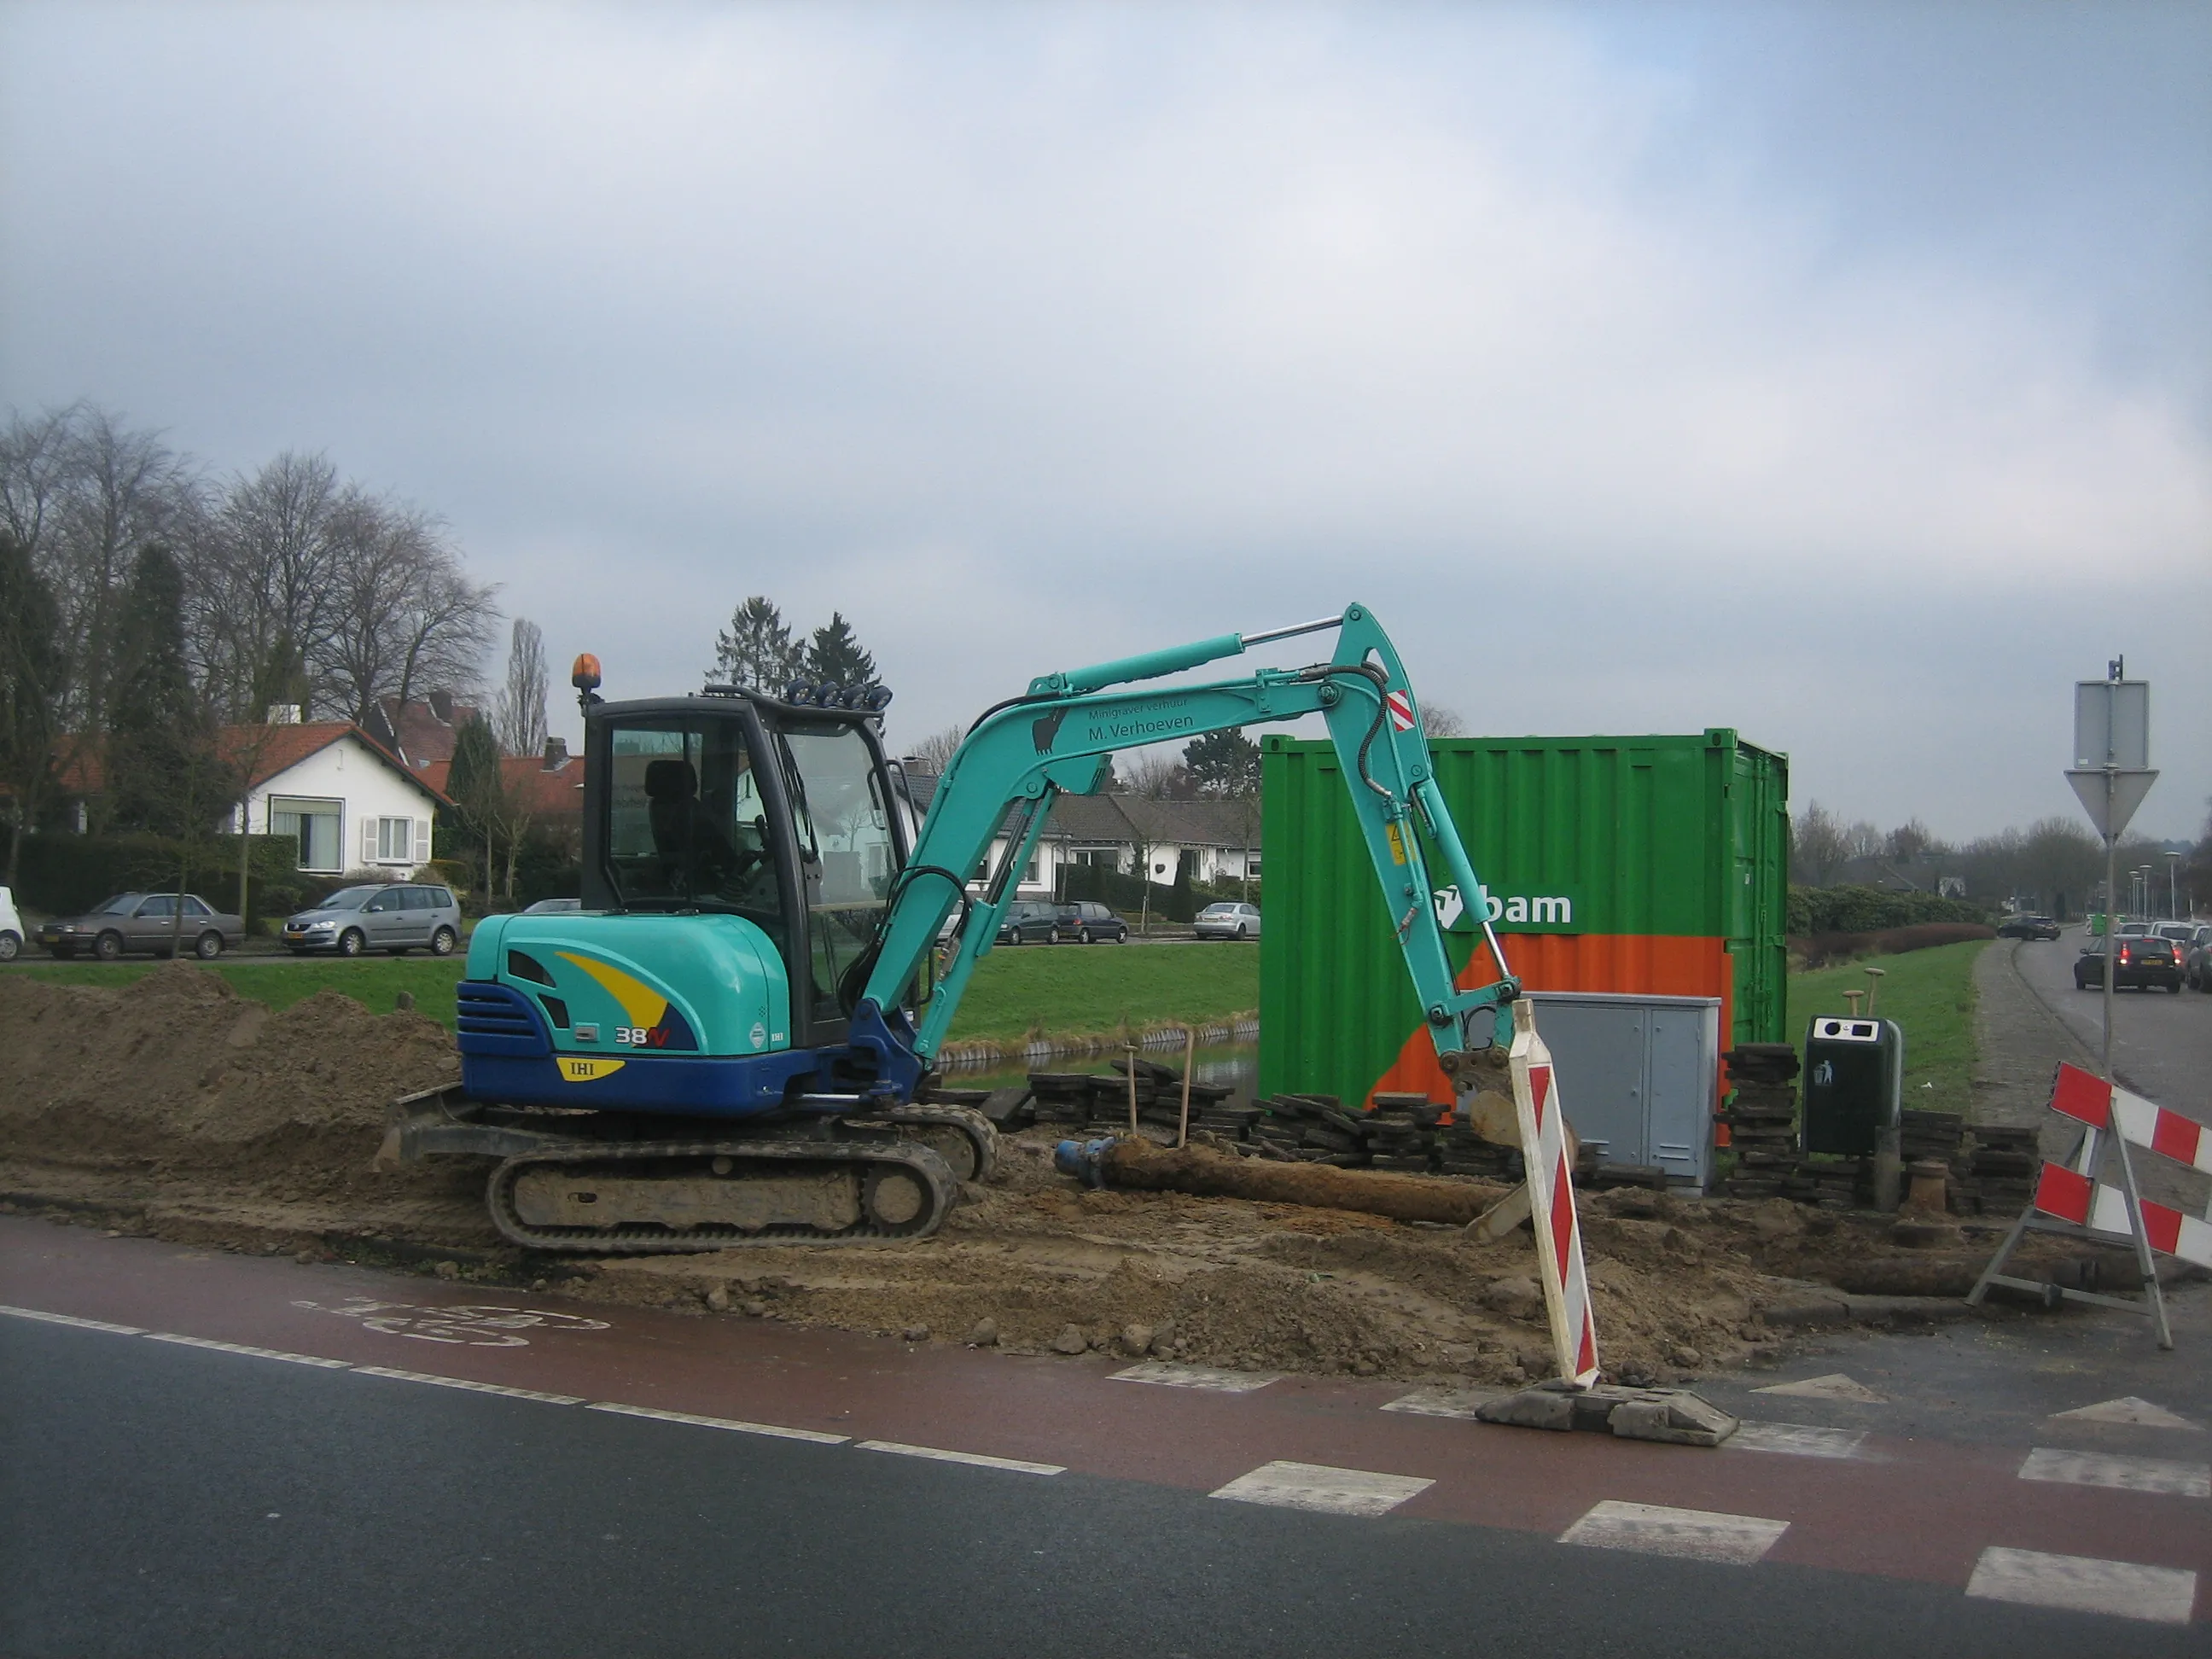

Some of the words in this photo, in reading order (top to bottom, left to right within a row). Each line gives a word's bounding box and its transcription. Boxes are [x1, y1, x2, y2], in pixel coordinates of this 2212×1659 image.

[1089, 705, 1144, 719] Minigraver
[1147, 698, 1187, 711] verhuur
[1089, 726, 1108, 741] M.
[1110, 716, 1194, 737] Verhoeven
[1478, 884, 1571, 923] bam
[771, 1032, 783, 1041] IHI
[570, 1062, 595, 1075] IHI
